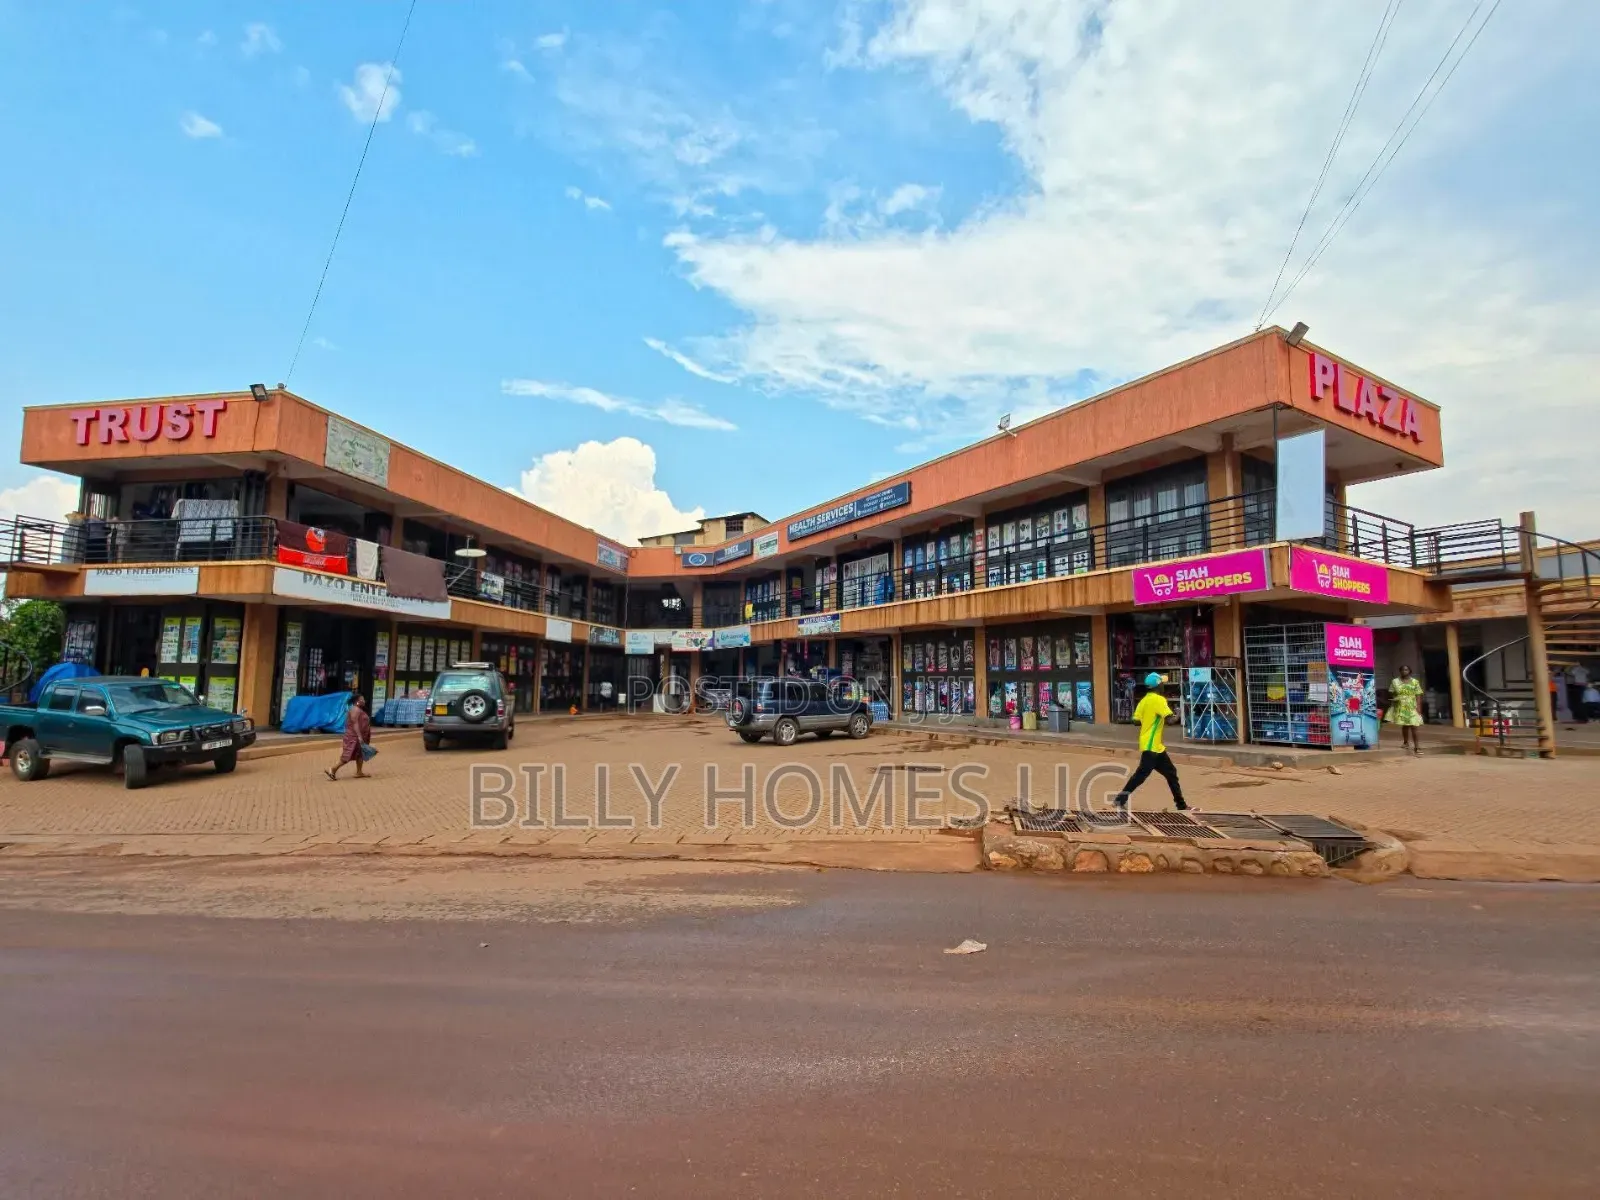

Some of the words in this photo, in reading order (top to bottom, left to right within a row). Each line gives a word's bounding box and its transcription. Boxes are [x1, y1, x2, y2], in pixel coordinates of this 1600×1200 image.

[1309, 352, 1422, 443] PLAZA
[71, 400, 227, 446] TRUST
[789, 518, 815, 534] HEALTH
[816, 503, 853, 525] SERVICES
[127, 567, 194, 575] ENTERPRISES
[1176, 566, 1209, 581] SIAH
[1331, 564, 1350, 578] SIAH
[1177, 572, 1252, 592] SHOPPERS
[1332, 577, 1371, 594] SHOPPERS
[1338, 636, 1361, 649] SIAH
[1334, 648, 1367, 659] SHOPPERS
